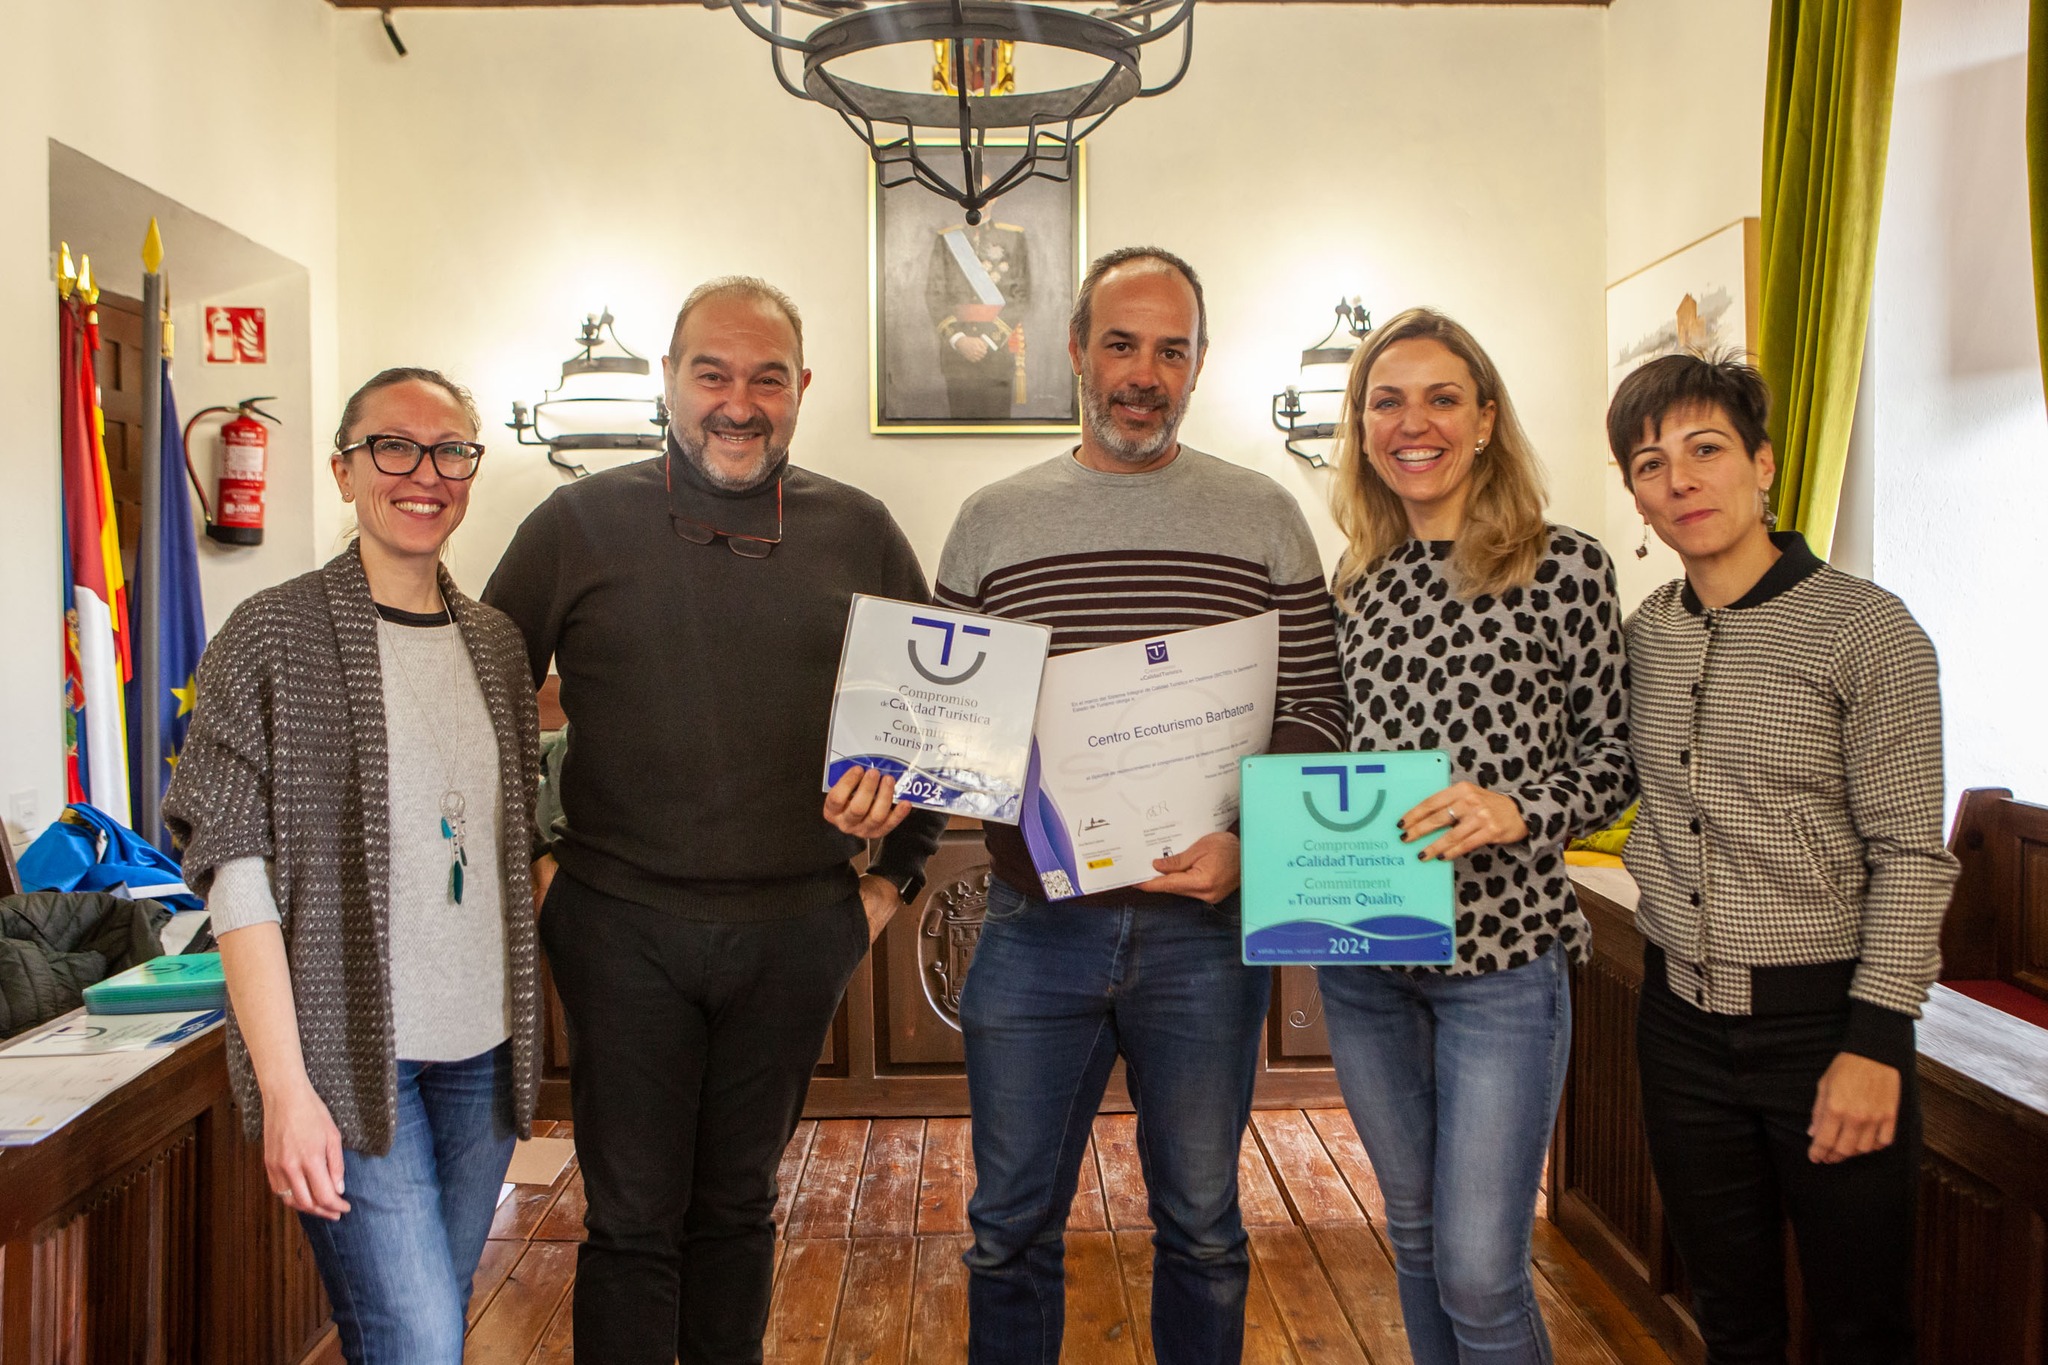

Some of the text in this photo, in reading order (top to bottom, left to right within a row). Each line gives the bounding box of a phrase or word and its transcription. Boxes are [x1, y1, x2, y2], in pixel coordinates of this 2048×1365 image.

[898, 684, 978, 708] Compromiso
[1088, 701, 1255, 747] Centro Ecoturismo Barbatona
[883, 731, 933, 752] Tourism
[903, 781, 942, 800] 2024
[1303, 839, 1389, 853] Compromiso
[1296, 854, 1346, 867] Calidad
[1304, 878, 1391, 889] Commitment
[1296, 893, 1351, 906] Tourism
[1355, 892, 1404, 907] Quality
[1328, 938, 1370, 955] 2024
